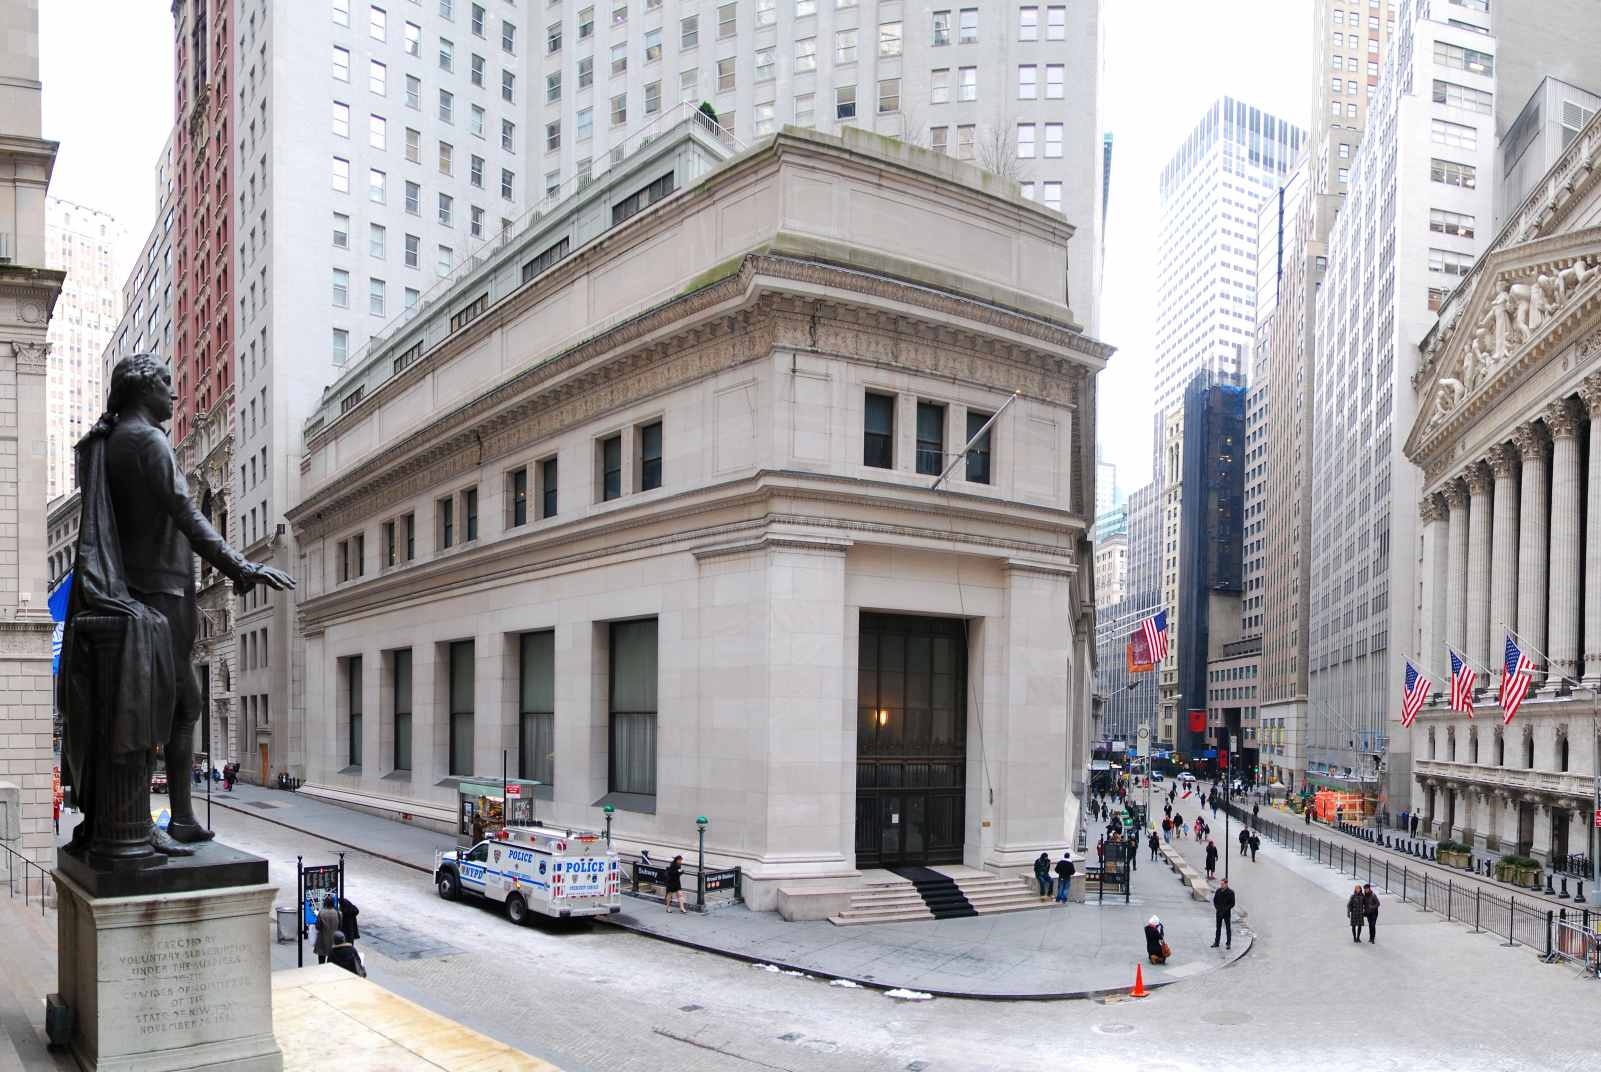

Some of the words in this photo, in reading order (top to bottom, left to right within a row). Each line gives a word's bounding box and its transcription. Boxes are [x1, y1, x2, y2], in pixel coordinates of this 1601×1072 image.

[508, 849, 533, 863] POLICE
[465, 866, 484, 879] NYPD
[566, 861, 605, 873] POLICE
